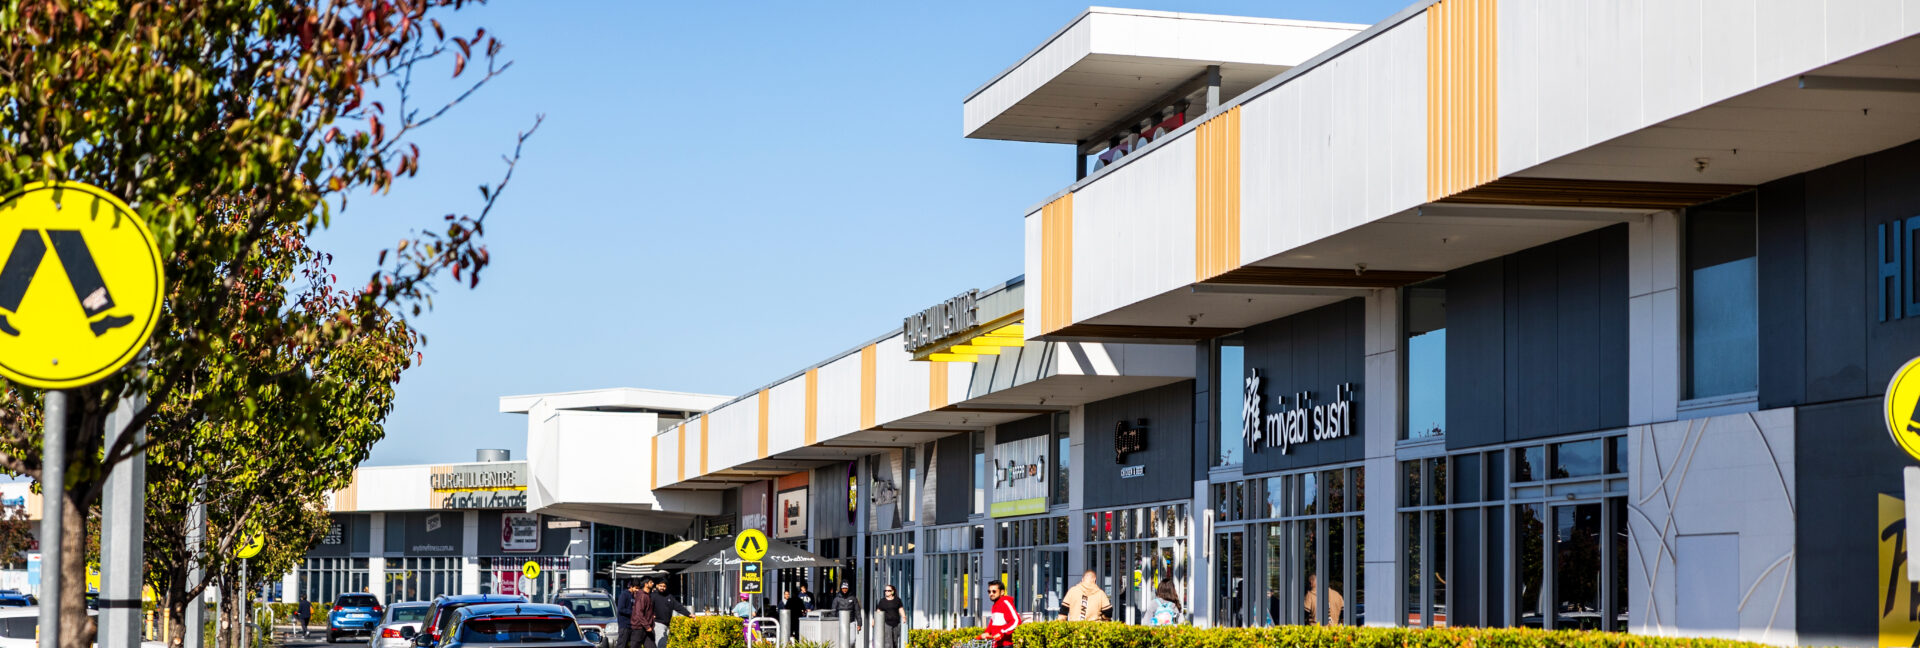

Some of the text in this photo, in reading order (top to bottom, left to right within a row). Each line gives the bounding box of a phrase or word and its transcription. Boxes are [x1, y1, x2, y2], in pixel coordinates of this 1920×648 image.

[904, 289, 979, 352] CHURCHILL CENTRE
[1267, 382, 1350, 455] miyabi sushi
[430, 470, 516, 489] CHURCHILL CENTRE
